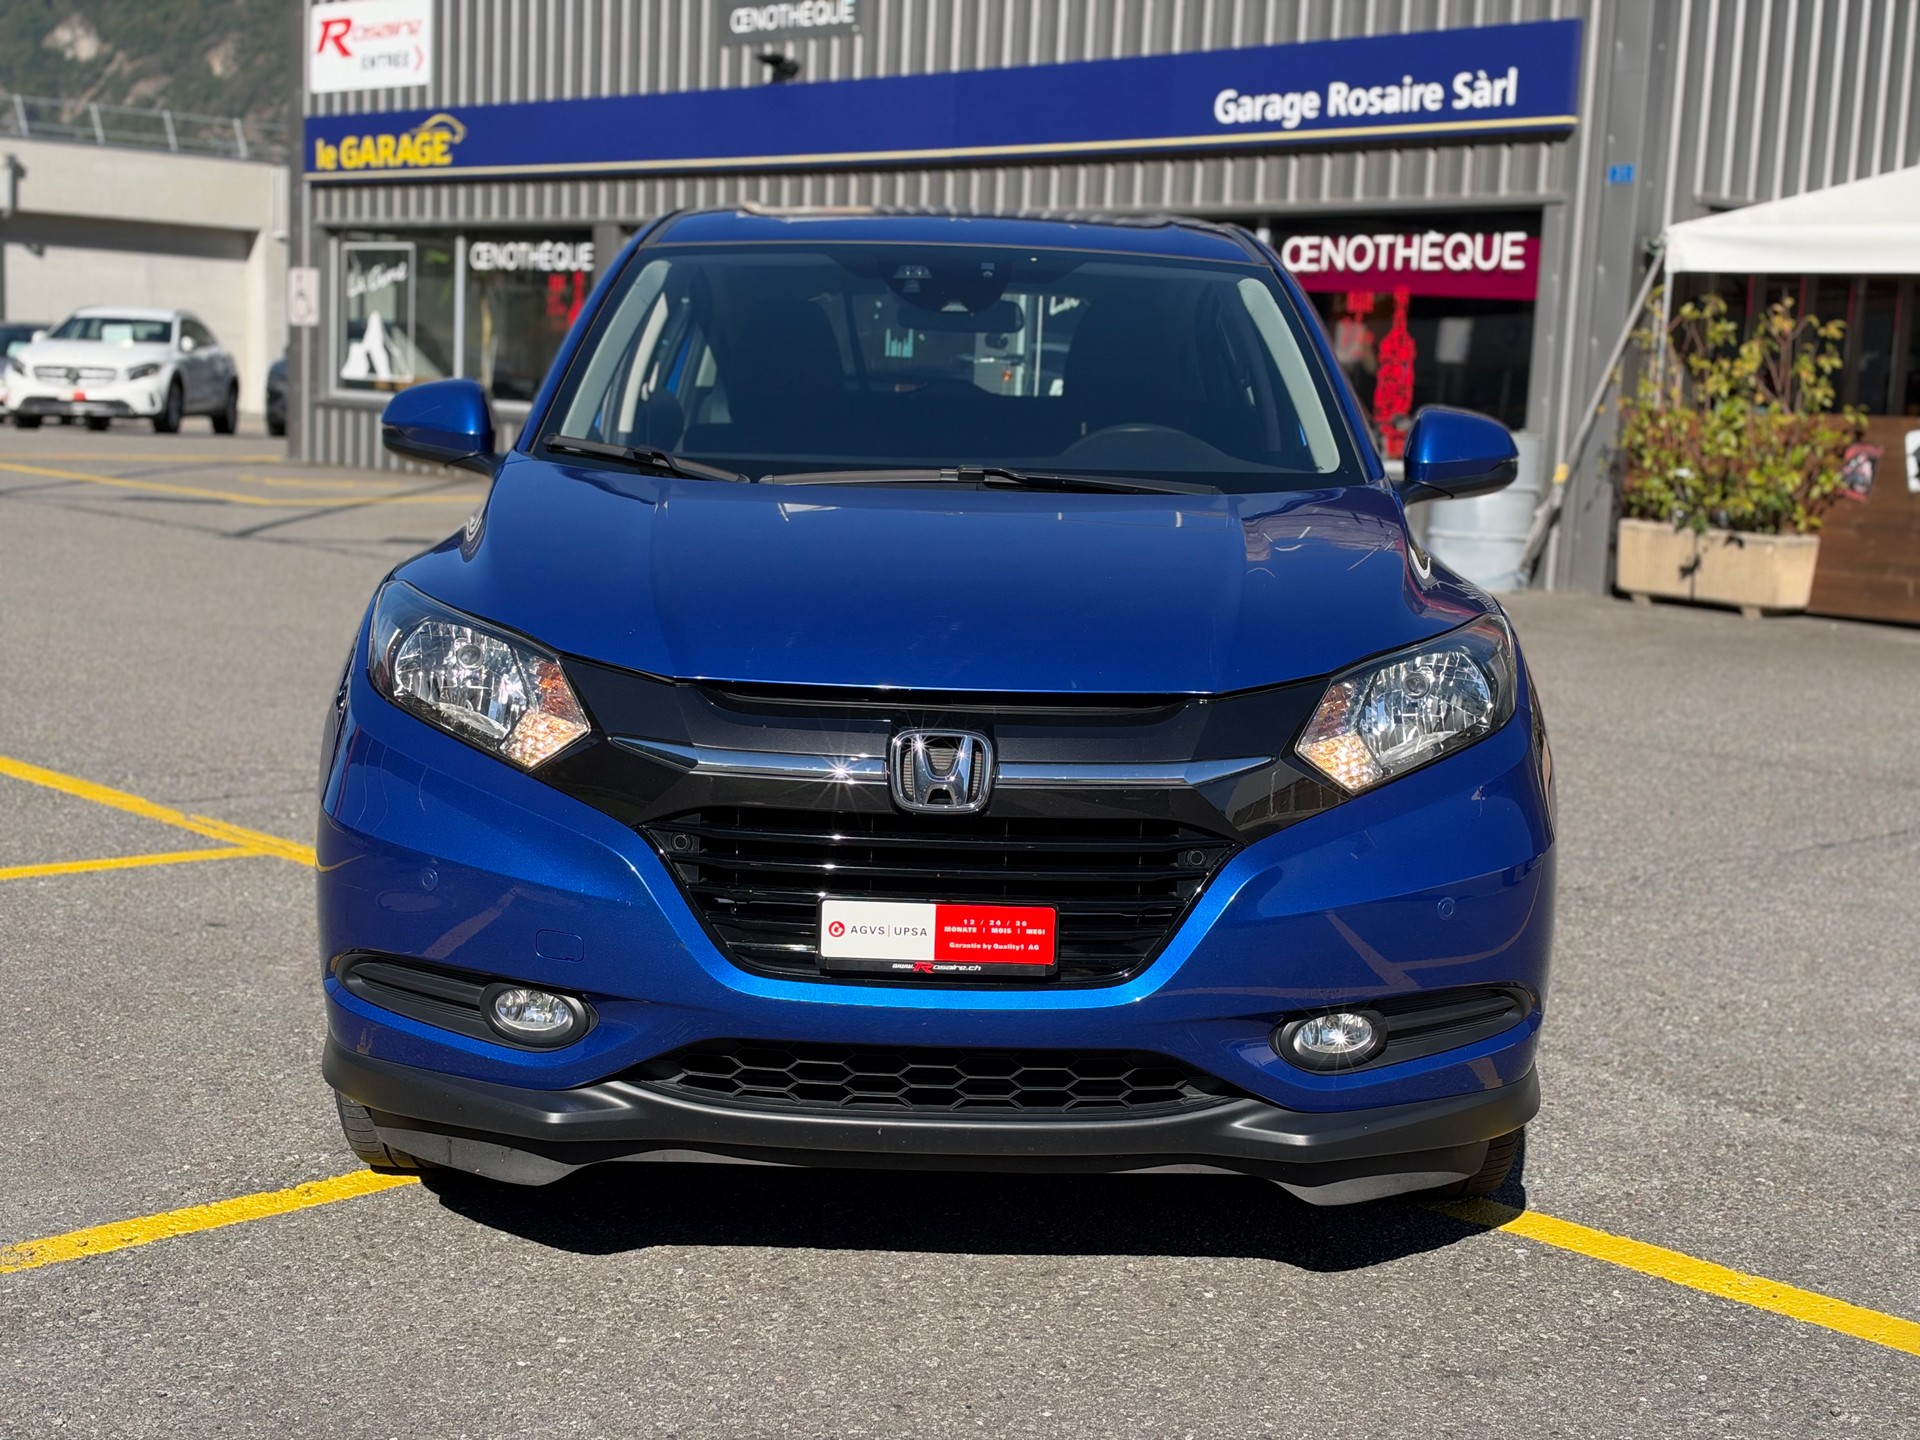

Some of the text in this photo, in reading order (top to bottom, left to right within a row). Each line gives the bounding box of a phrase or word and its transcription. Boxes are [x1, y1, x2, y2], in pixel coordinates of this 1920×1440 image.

[1213, 66, 1519, 130] Garage Rosaire Sàrl
[315, 130, 453, 170] le GARAGE
[1281, 230, 1527, 272] ŒNOTHÈQUE
[850, 925, 928, 937] AGVS UPSA
[991, 927, 1012, 935] MOIS
[1026, 928, 1046, 936] MESI
[982, 943, 992, 951] by
